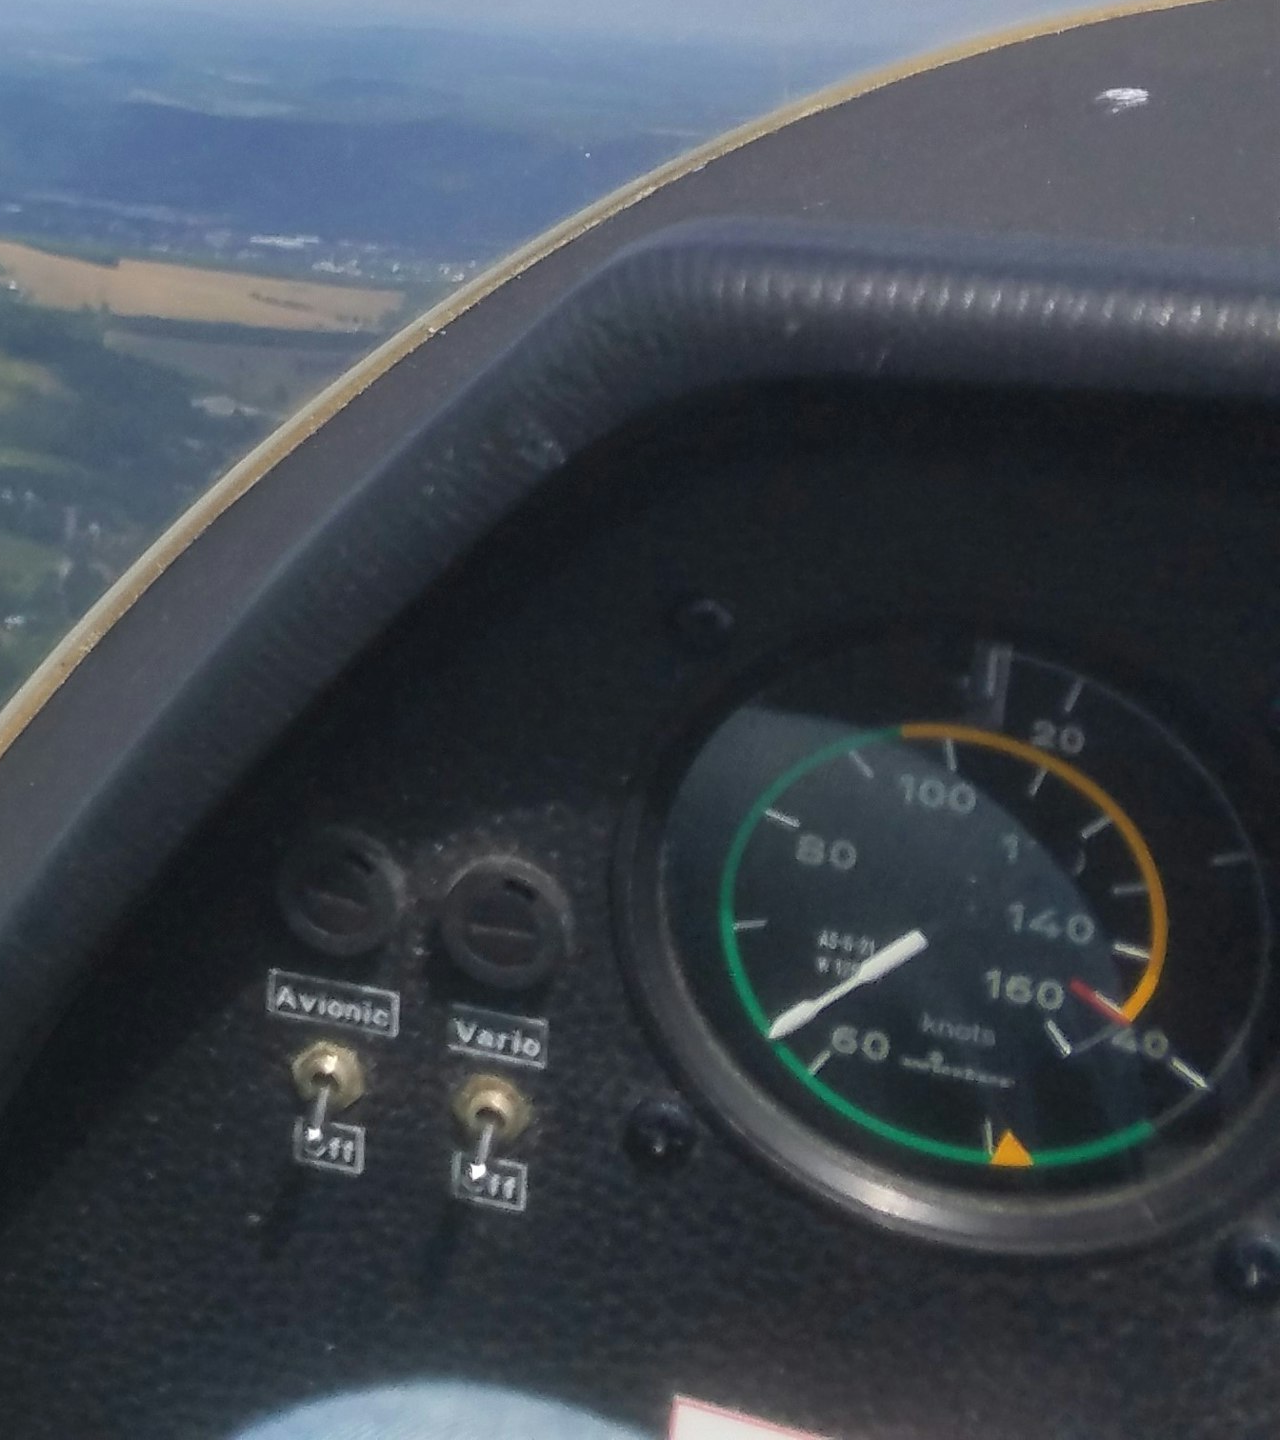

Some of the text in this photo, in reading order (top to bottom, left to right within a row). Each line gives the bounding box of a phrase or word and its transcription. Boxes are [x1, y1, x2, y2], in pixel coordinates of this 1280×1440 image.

[899, 773, 978, 814] 100
[794, 833, 858, 871] 80
[1008, 903, 1097, 945] 140
[275, 984, 390, 1028] Avionic
[985, 968, 1066, 1012] 160
[453, 1015, 542, 1059] Vario
[831, 1023, 890, 1062] 60
